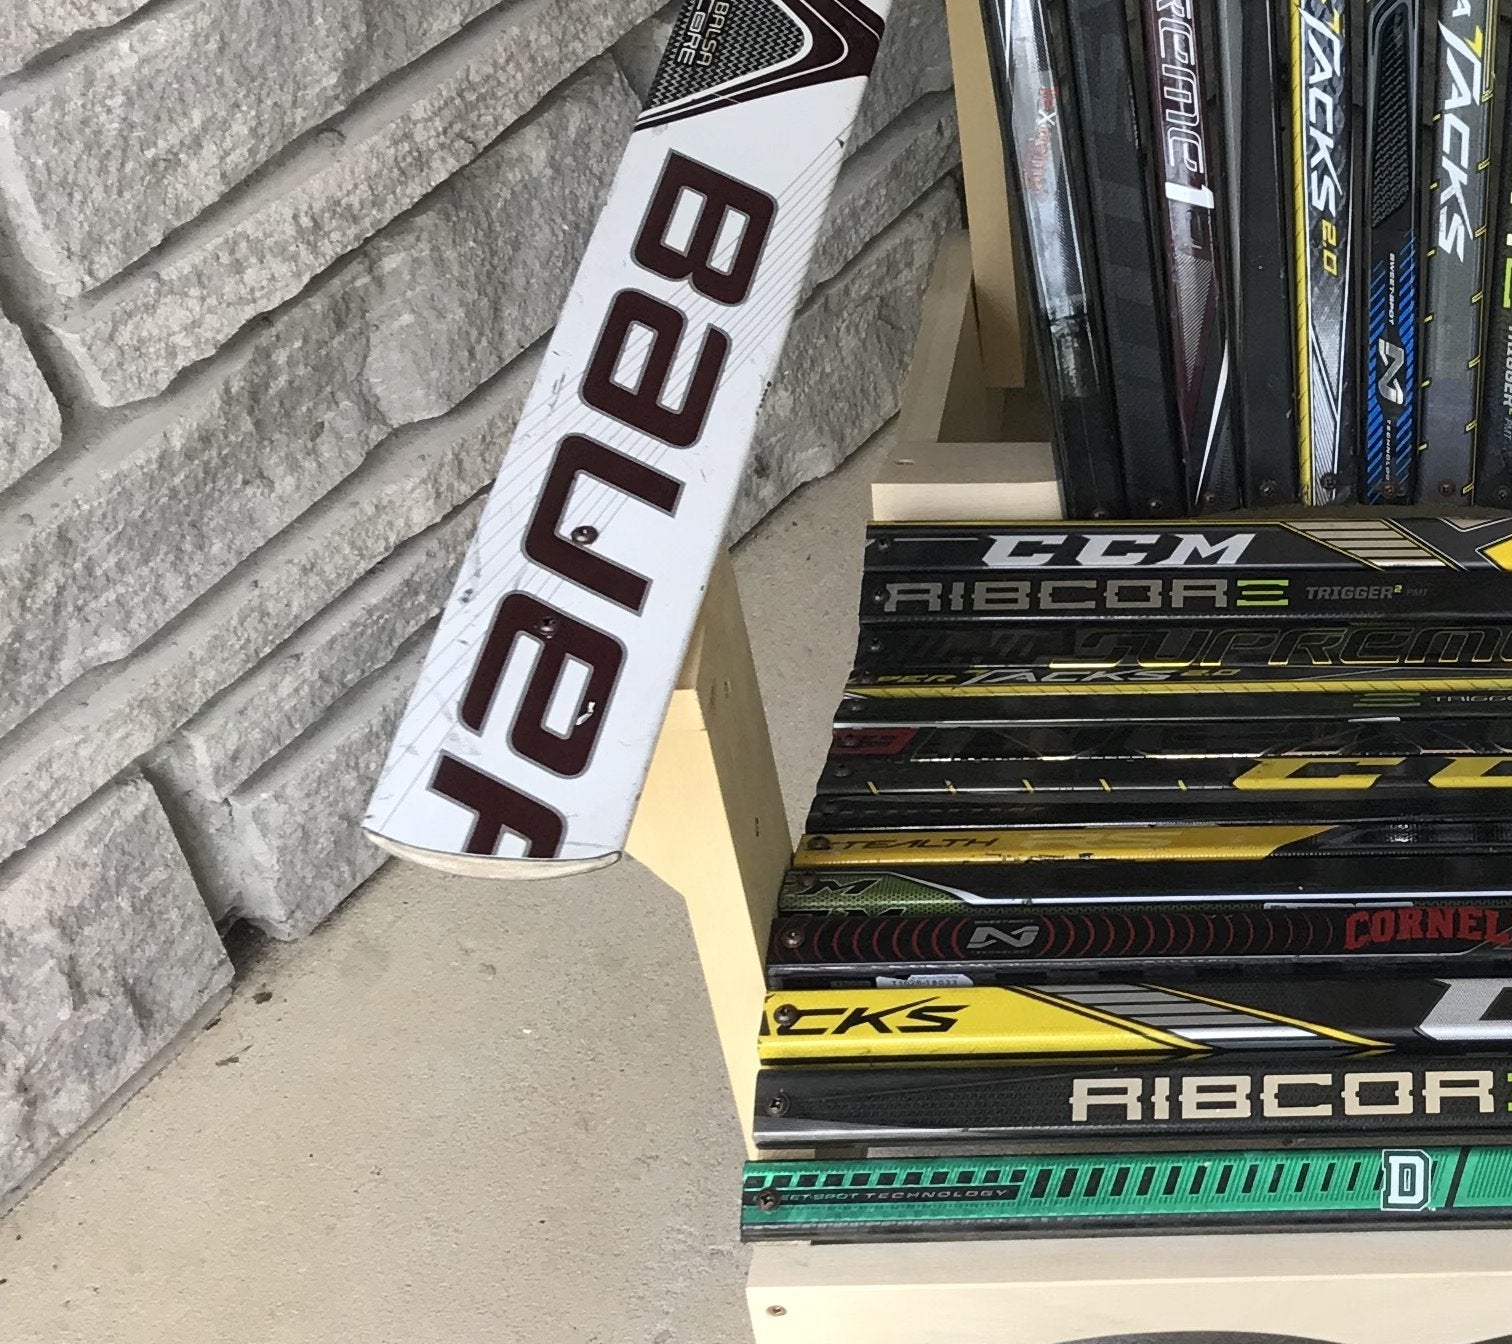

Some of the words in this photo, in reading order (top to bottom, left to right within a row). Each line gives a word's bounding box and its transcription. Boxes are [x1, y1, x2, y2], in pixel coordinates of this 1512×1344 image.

[696, 1, 730, 68] BALSA
[1297, 1, 1345, 213] TACKS
[1432, 16, 1485, 265] TACKS
[1319, 224, 1340, 279] 2.0
[1384, 418, 1393, 486] TECHNOLOG
[981, 533, 1257, 567] CCM
[953, 667, 1176, 687] TACKS
[1180, 668, 1241, 680] 2.0
[764, 995, 970, 1036] CKS
[864, 1189, 1009, 1201] TECHNOLOGY
